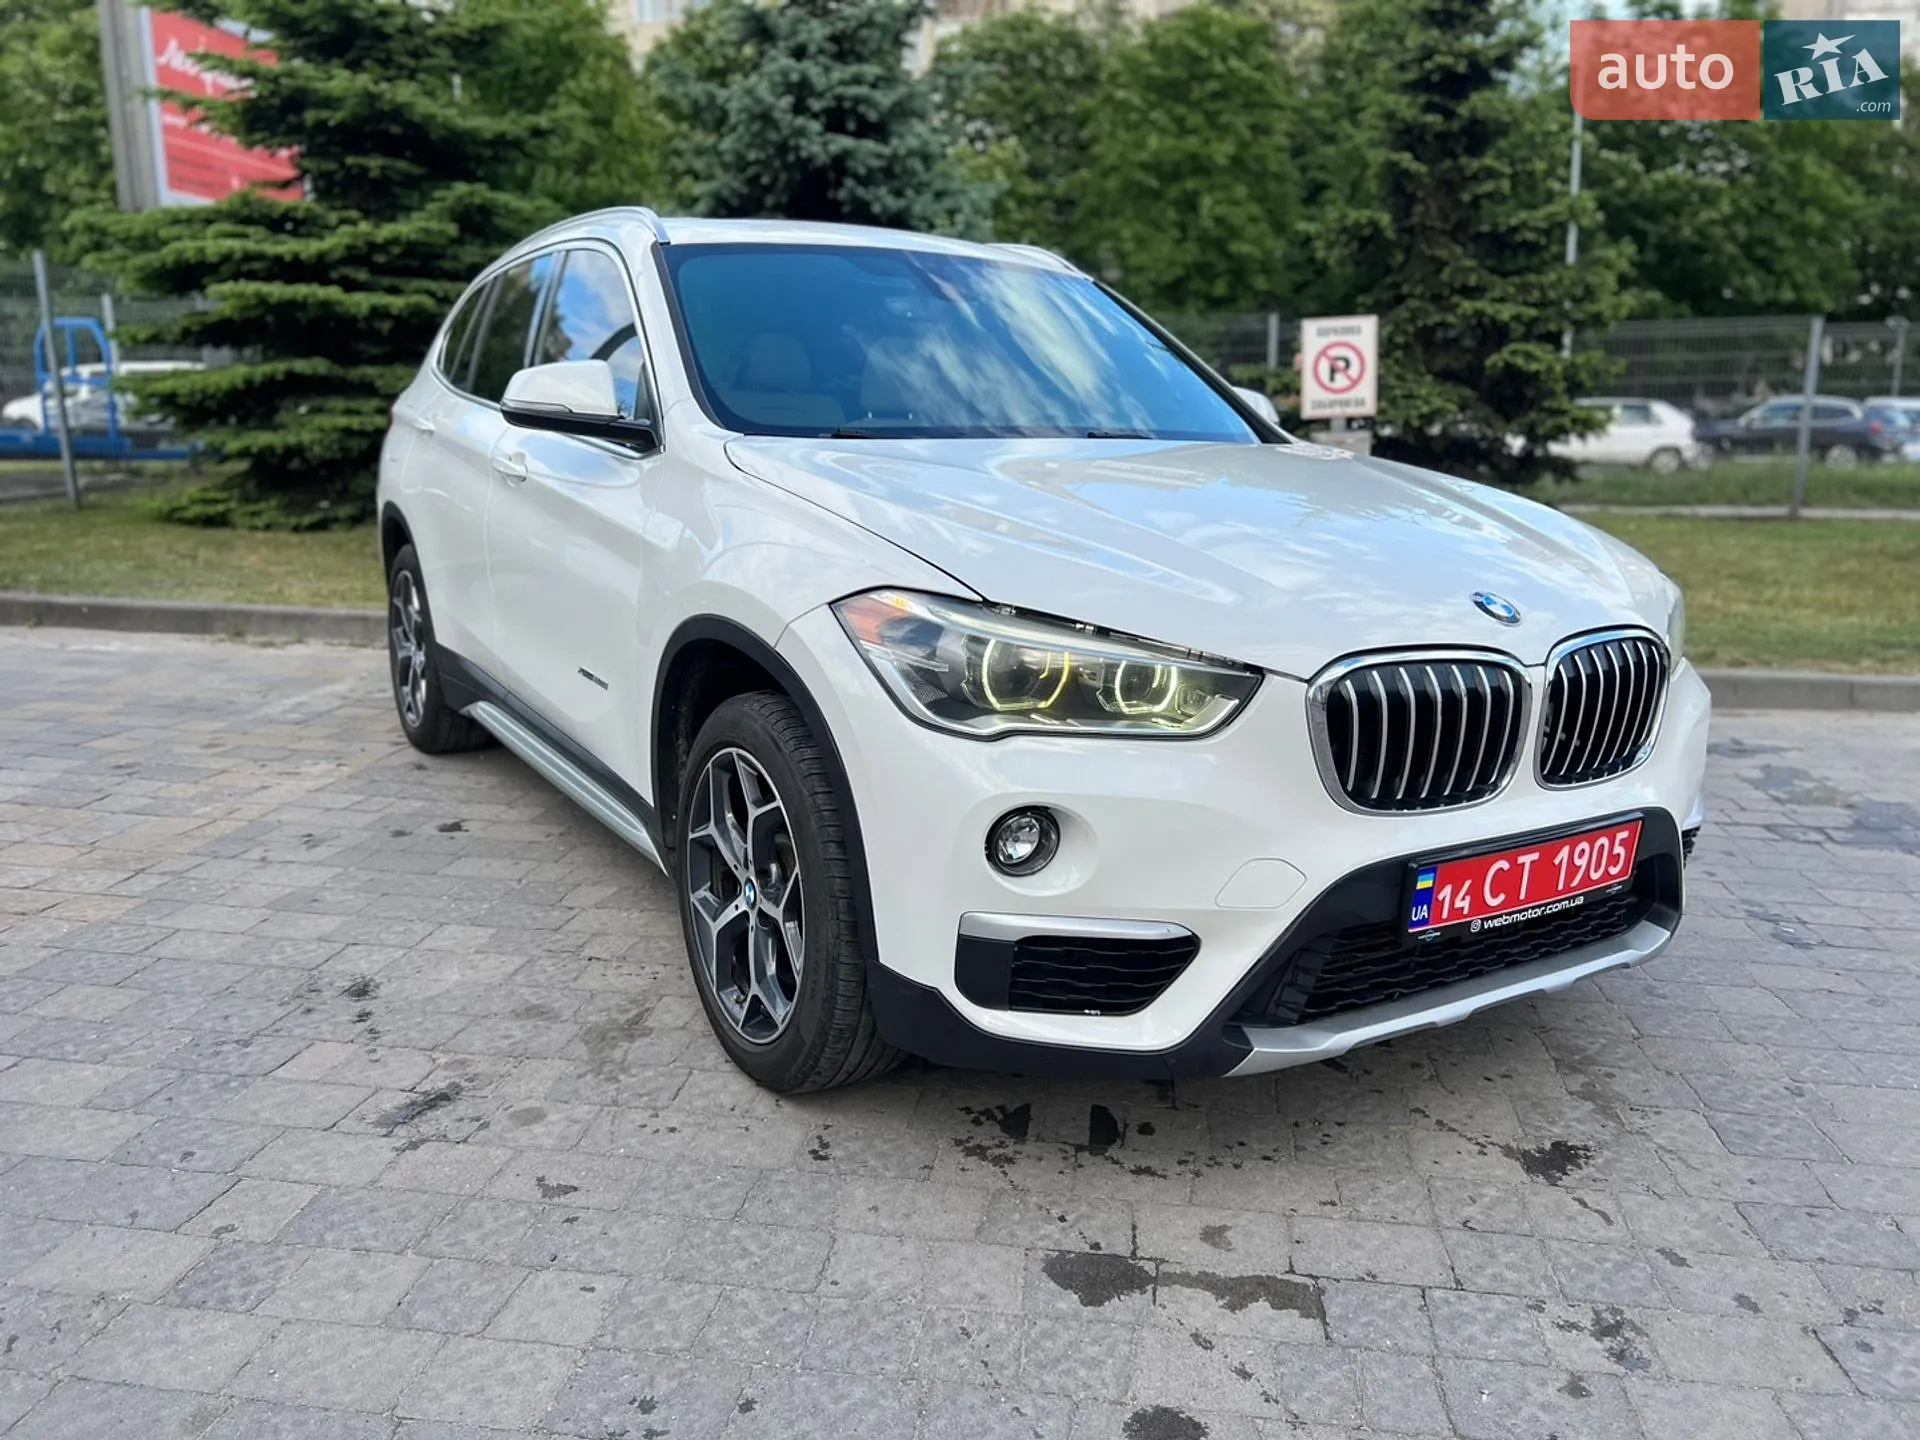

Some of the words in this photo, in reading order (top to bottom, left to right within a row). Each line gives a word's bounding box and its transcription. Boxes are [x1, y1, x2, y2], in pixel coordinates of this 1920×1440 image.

[1438, 879, 1471, 919] 14
[1483, 851, 1540, 907] CT
[1554, 830, 1629, 891] 1905
[1411, 905, 1428, 921] UA
[1483, 896, 1584, 929] webmotor.com.ua
